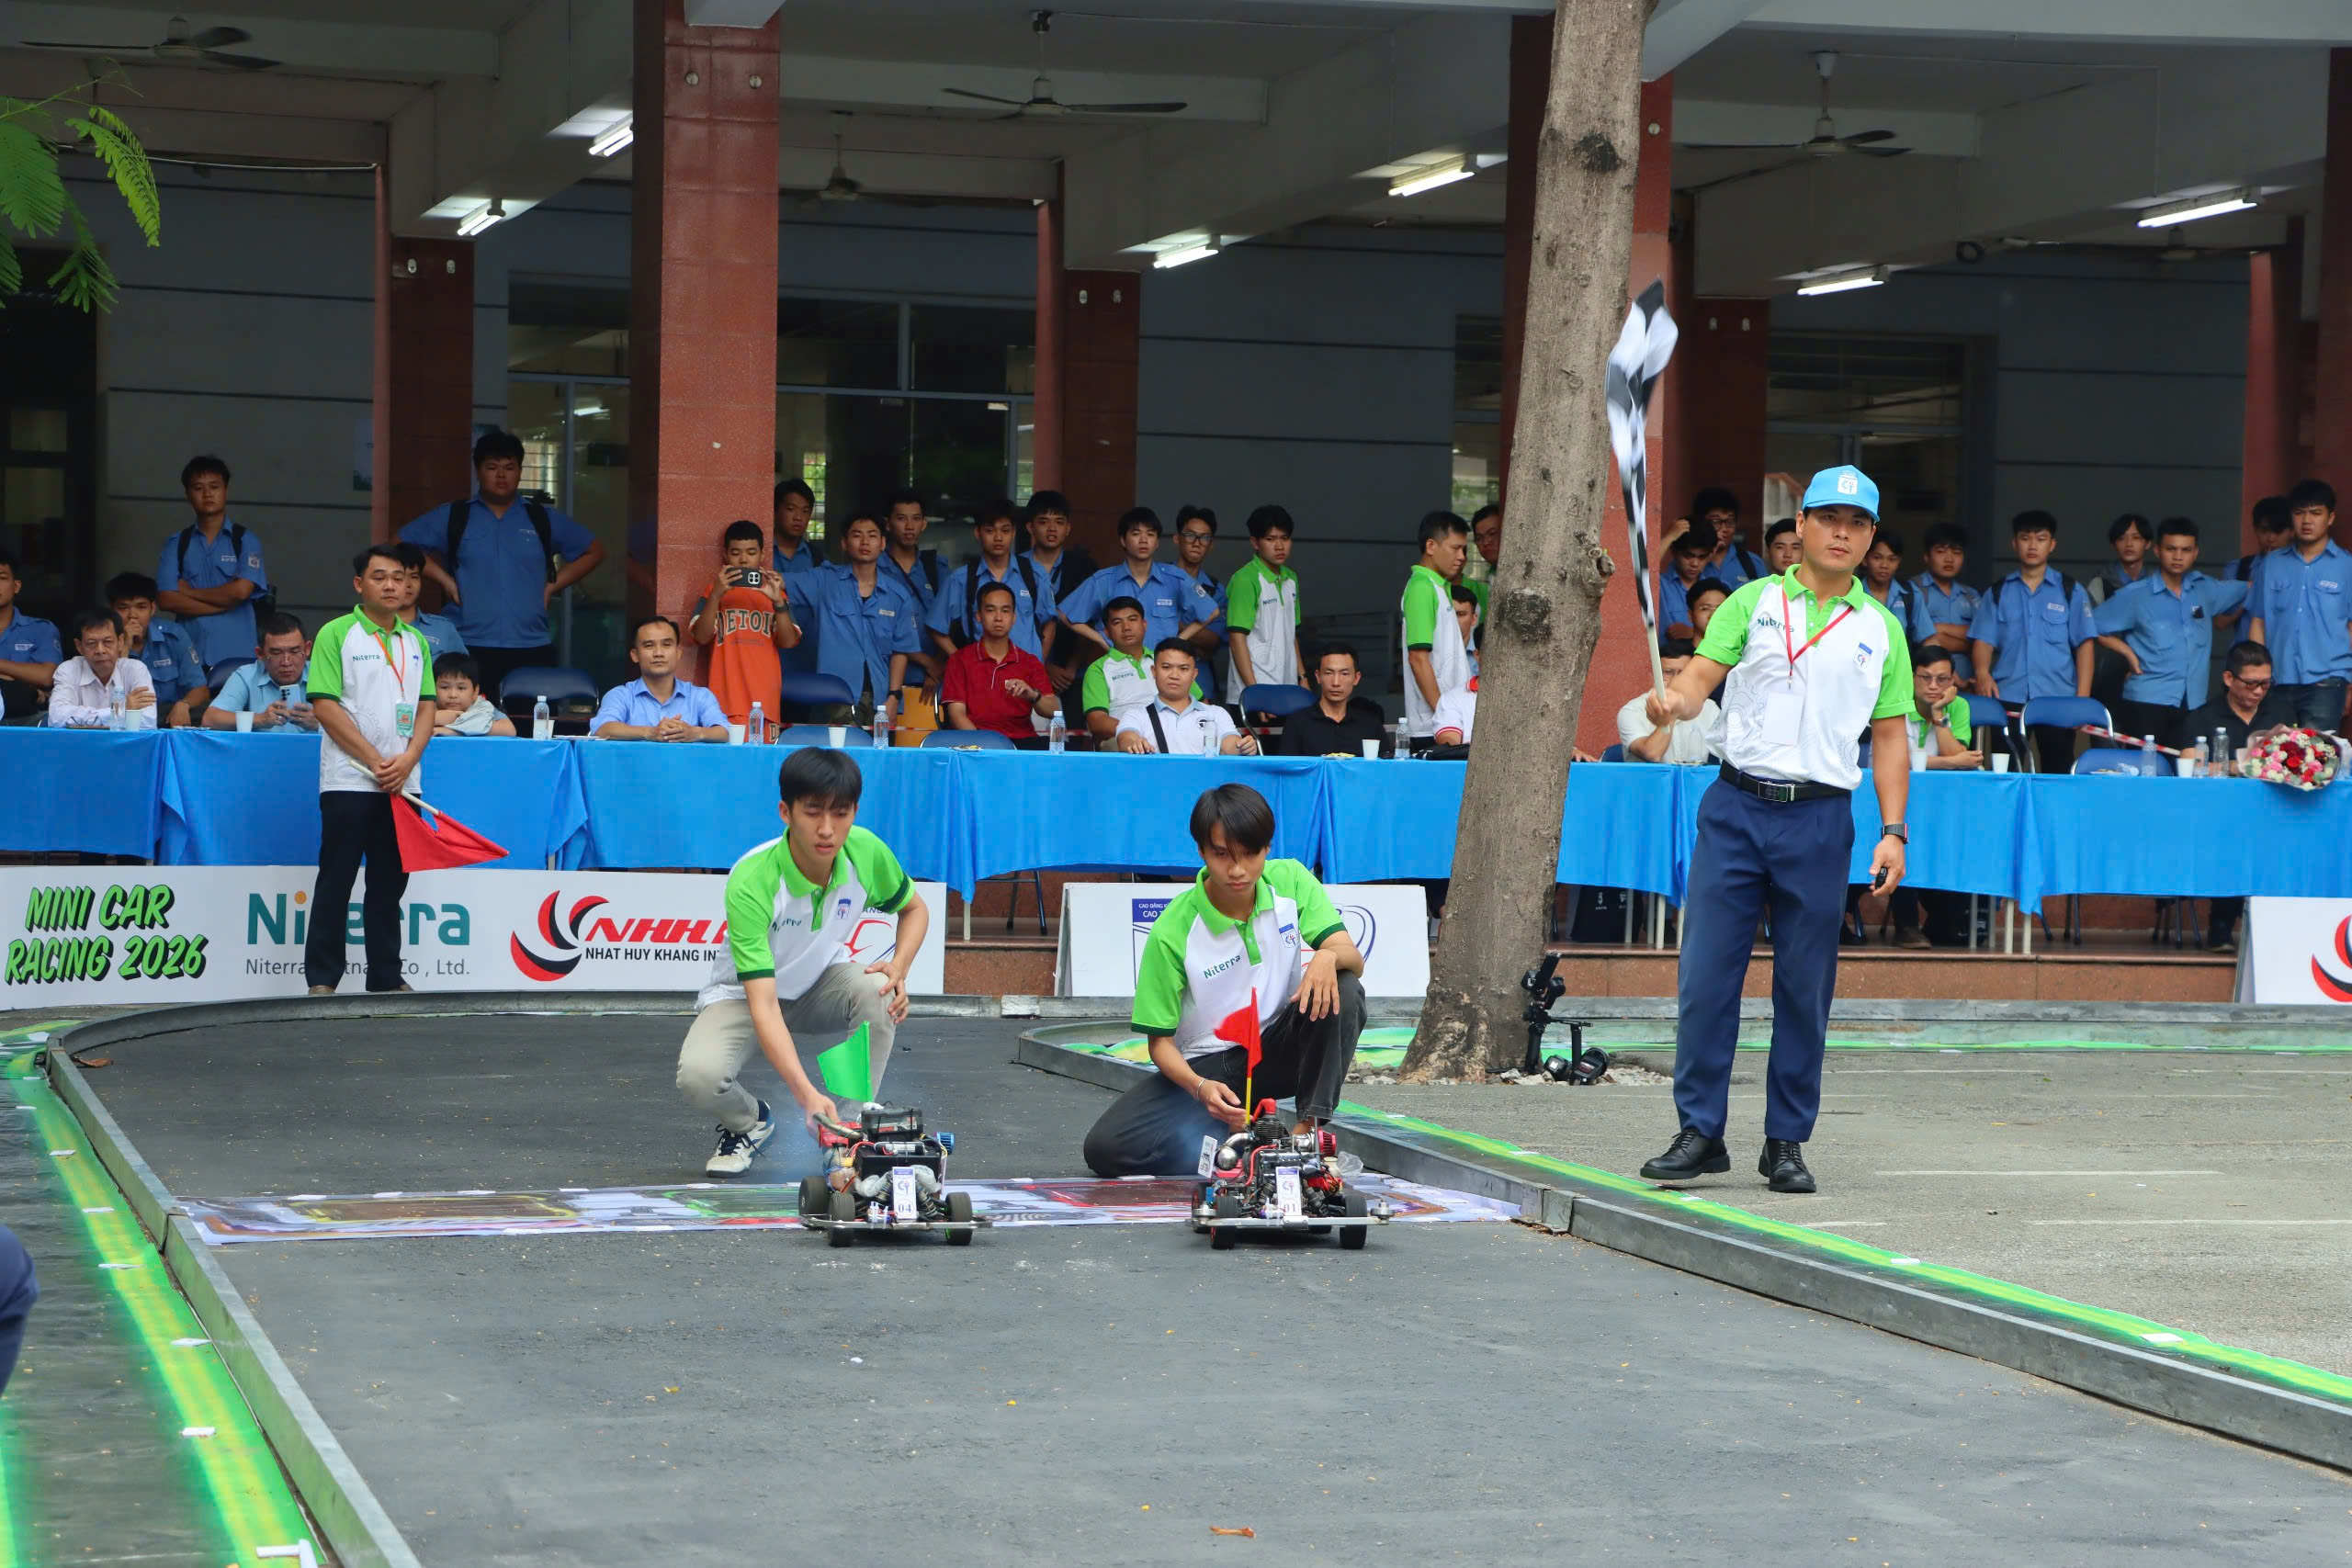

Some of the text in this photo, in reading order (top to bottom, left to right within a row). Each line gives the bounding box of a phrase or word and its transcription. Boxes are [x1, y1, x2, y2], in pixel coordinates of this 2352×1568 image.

[25, 885, 175, 932] MINI CAR
[247, 890, 470, 945] Niera
[5, 933, 209, 986] RACING 2026
[245, 958, 306, 975] Niterra
[437, 958, 470, 975] Ltd.
[585, 947, 720, 962] NHAT HUY KHANG IN
[1204, 954, 1241, 979] Niterra
[898, 1203, 912, 1213] 04
